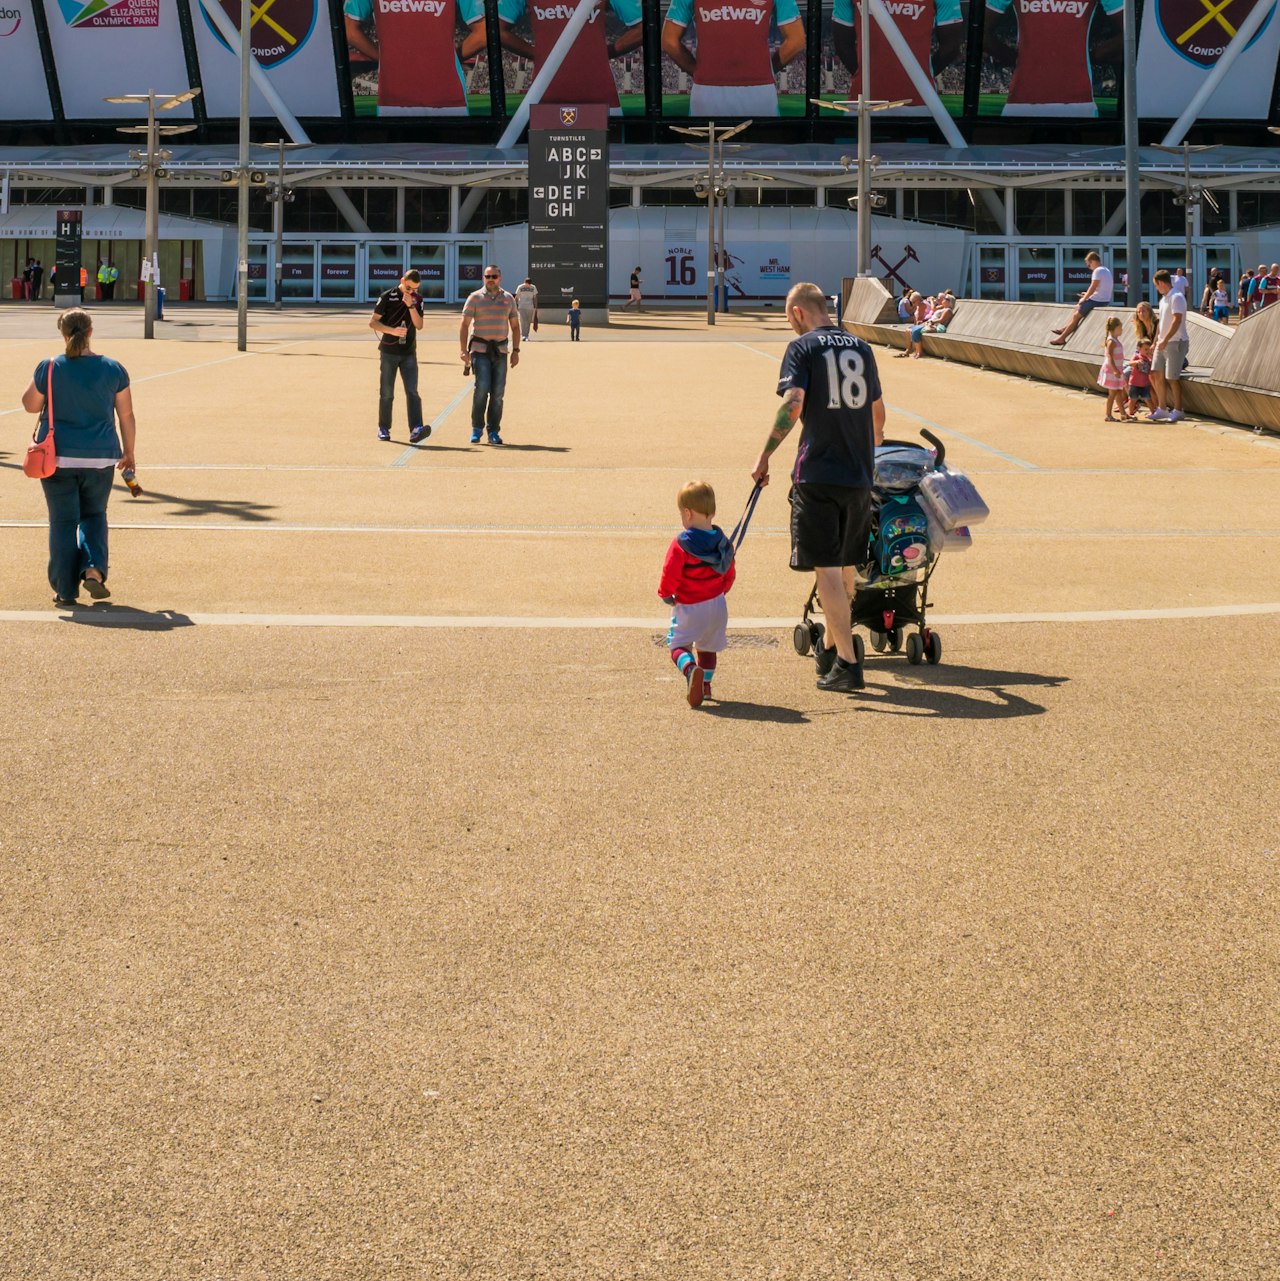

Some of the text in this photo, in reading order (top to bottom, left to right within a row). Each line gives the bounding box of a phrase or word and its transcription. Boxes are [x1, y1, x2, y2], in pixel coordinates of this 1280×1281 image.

[128, 0, 158, 8] QUEEN
[110, 8, 158, 17] ELIZABETH
[533, 4, 600, 24] betwy
[698, 5, 767, 24] betway
[93, 16, 158, 26] OLYMPIC PARK
[250, 45, 286, 56] ONDON
[1188, 44, 1229, 56] LONDO
[61, 223, 70, 235] H
[668, 247, 692, 255] NOBLE
[373, 268, 398, 277] blowing
[665, 255, 696, 285] 16
[759, 265, 790, 273] WEST HAM
[1027, 272, 1047, 280] pretty
[817, 335, 859, 347] PADDY
[822, 347, 867, 409] 18
